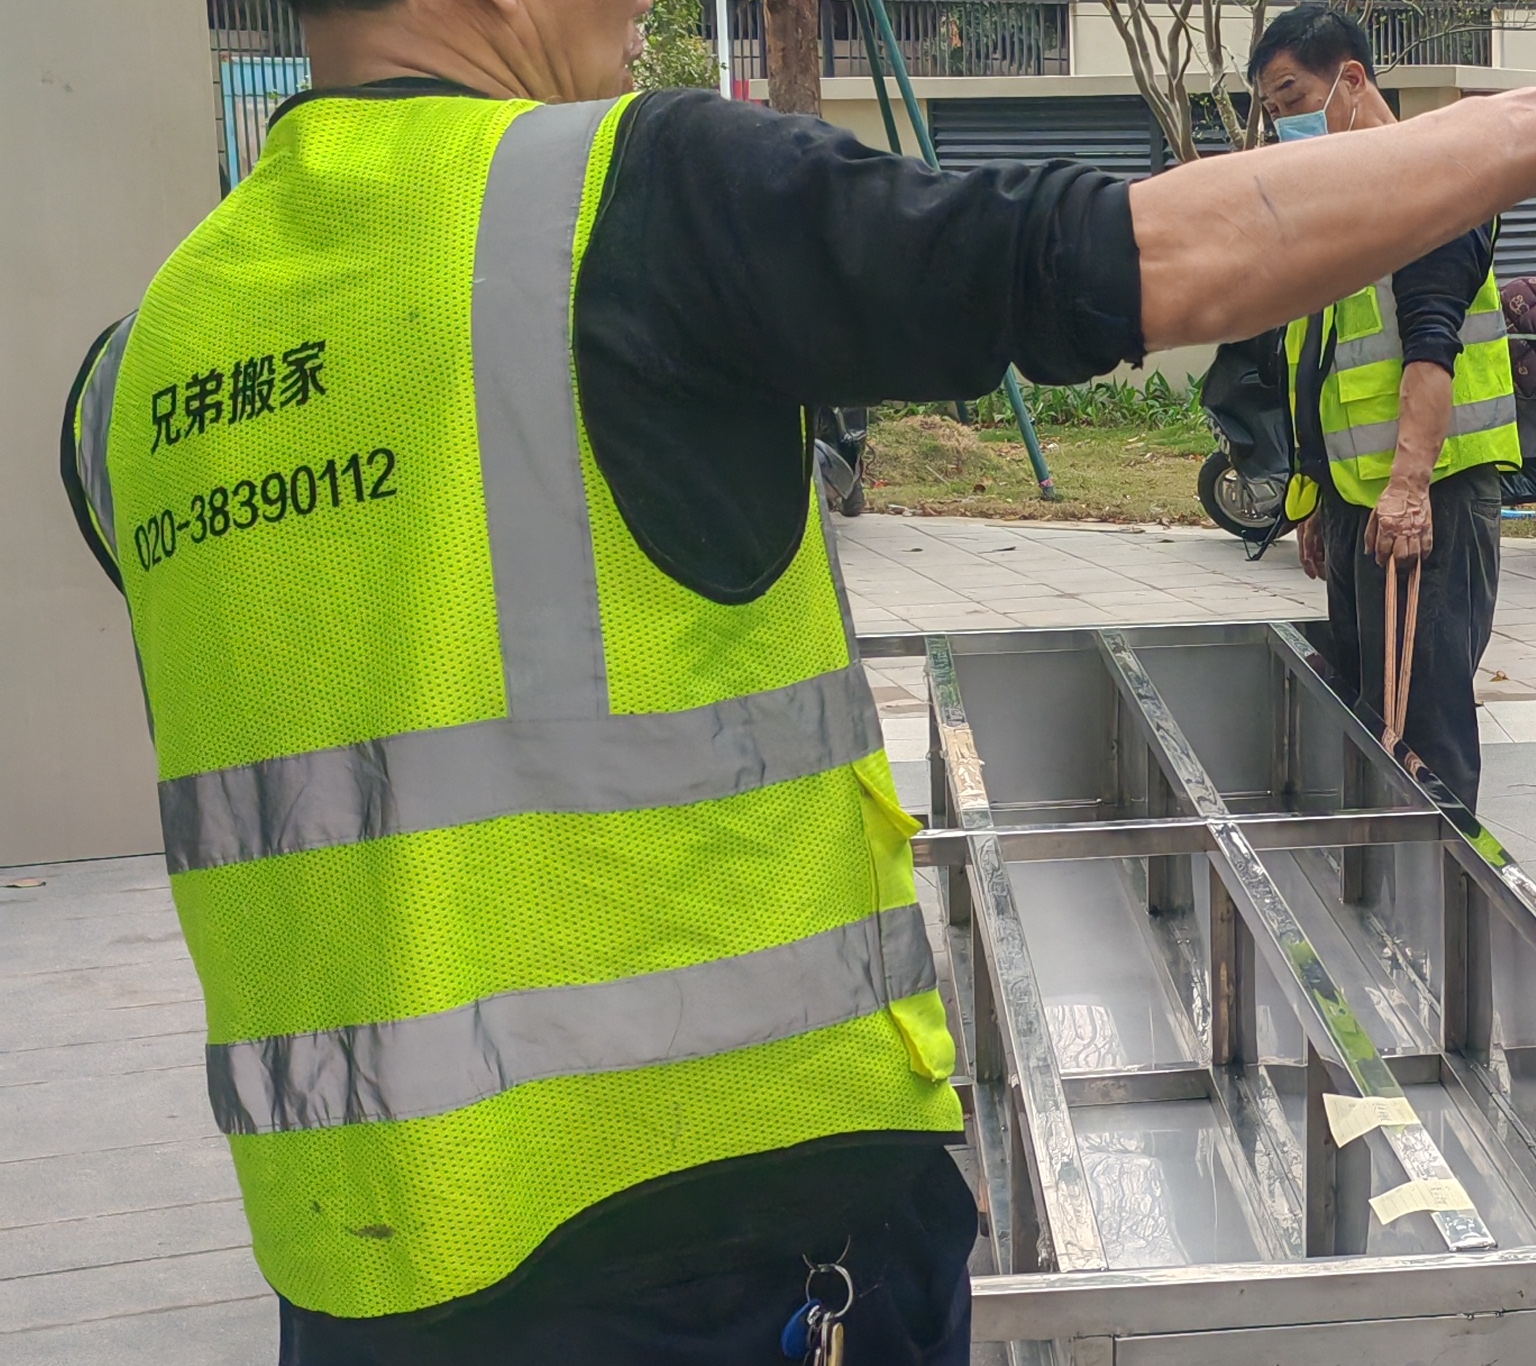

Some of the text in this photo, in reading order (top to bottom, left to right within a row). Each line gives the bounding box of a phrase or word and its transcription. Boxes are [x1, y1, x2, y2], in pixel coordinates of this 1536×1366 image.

[150, 339, 327, 455] 兄弟搬家
[134, 447, 398, 572] 020-38390112
